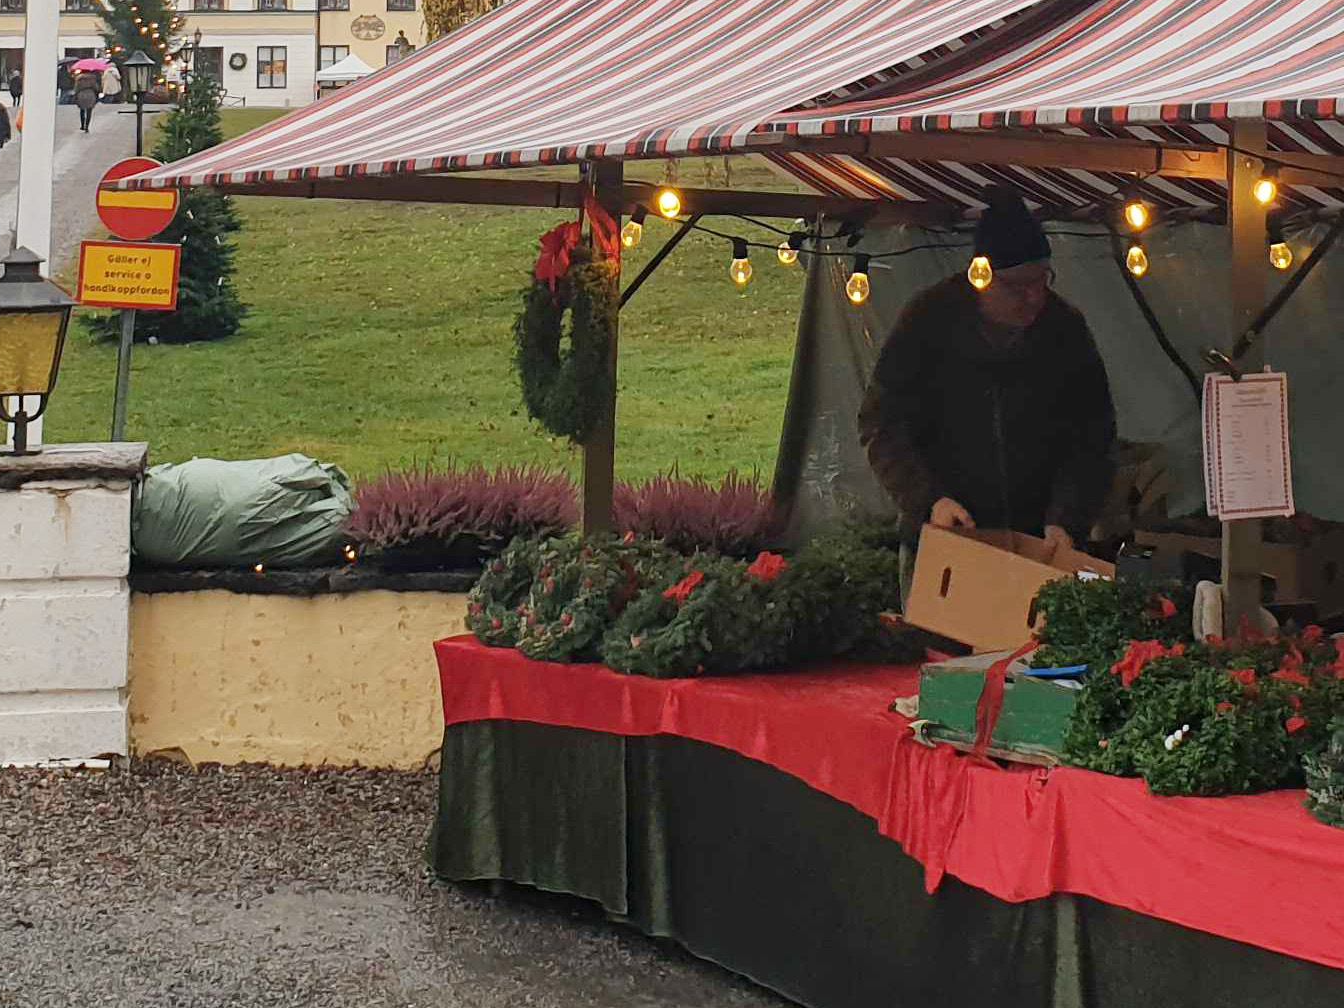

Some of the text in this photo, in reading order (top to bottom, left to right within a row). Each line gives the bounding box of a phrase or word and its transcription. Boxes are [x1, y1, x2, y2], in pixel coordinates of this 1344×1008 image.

[107, 254, 151, 267] Gäller ej
[104, 270, 141, 280] service
[84, 283, 169, 295] handikappfordon
